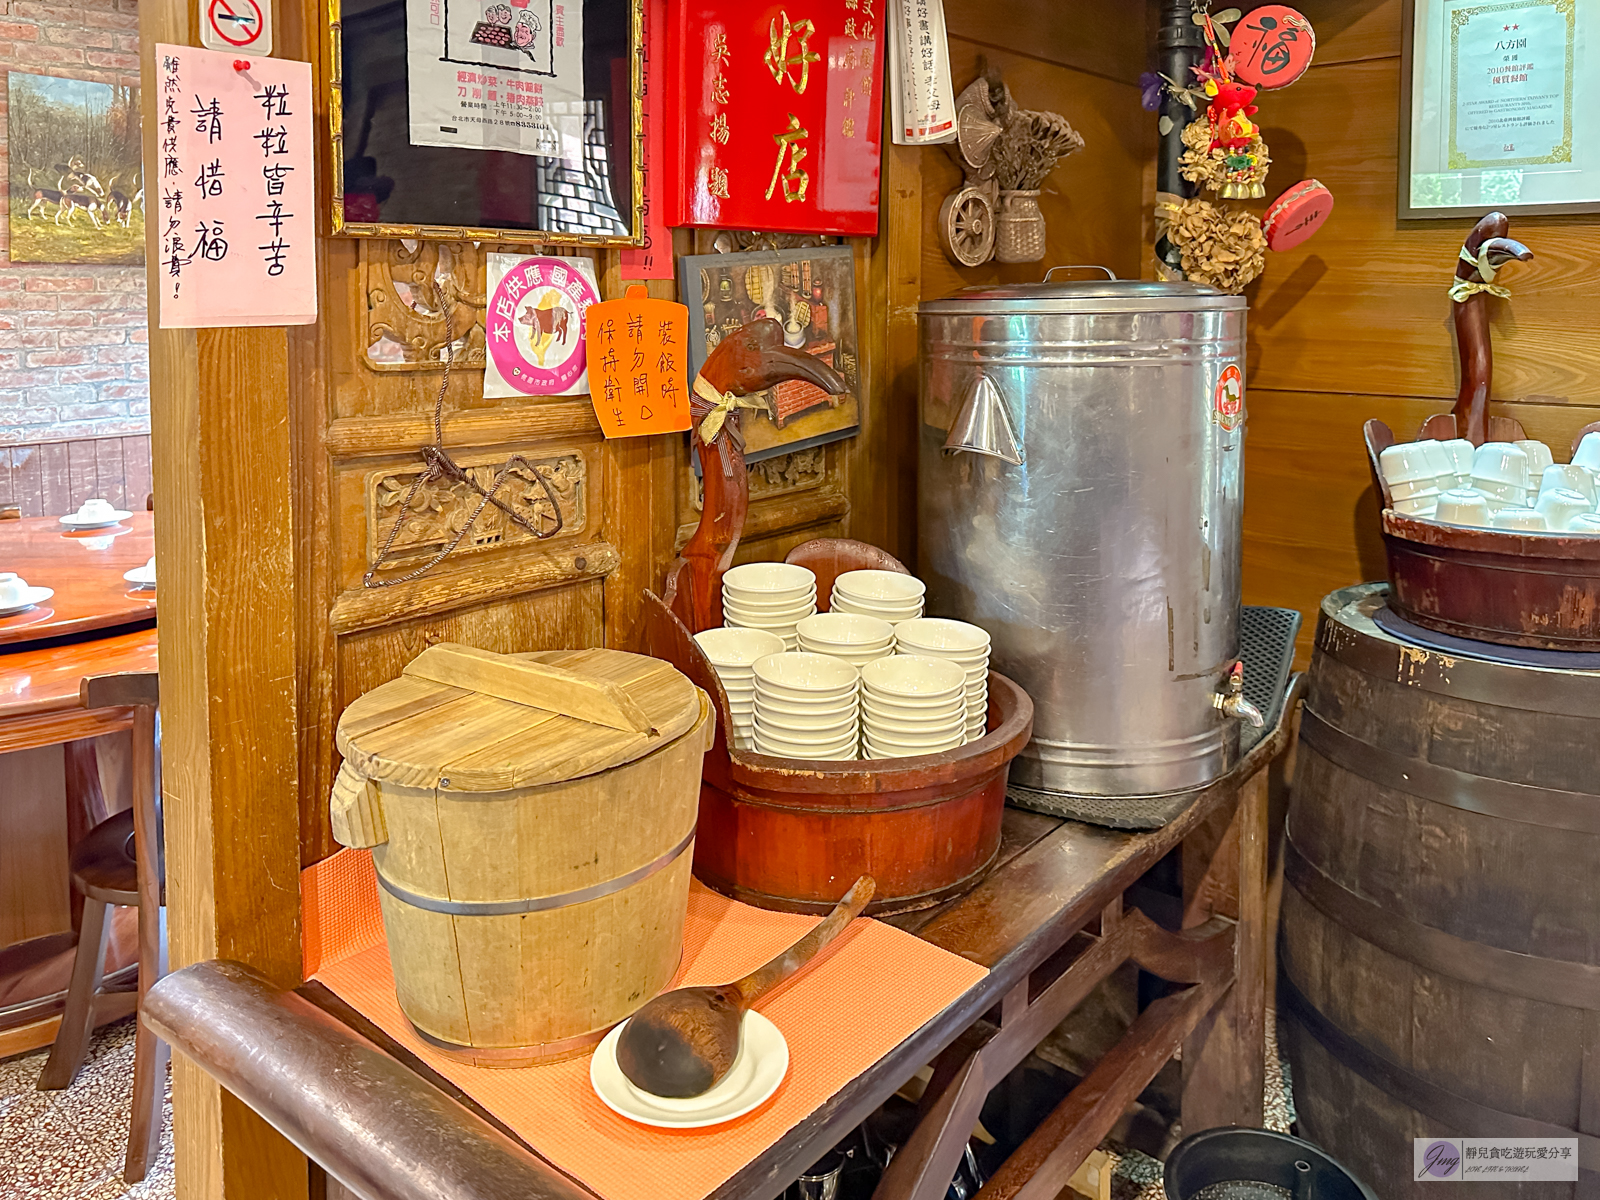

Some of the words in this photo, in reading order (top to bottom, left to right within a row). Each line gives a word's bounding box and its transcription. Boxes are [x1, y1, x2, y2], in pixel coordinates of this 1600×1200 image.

[1494, 37, 1527, 51] 八方園
[764, 10, 821, 203] 好店
[189, 95, 228, 260] 請惜福
[253, 84, 294, 276] 粒粒皆辛苦
[493, 264, 543, 343] 本店供應
[597, 319, 626, 427] 保持衛生
[626, 313, 653, 420] 請勿開口
[656, 320, 679, 408] 裝飯時
